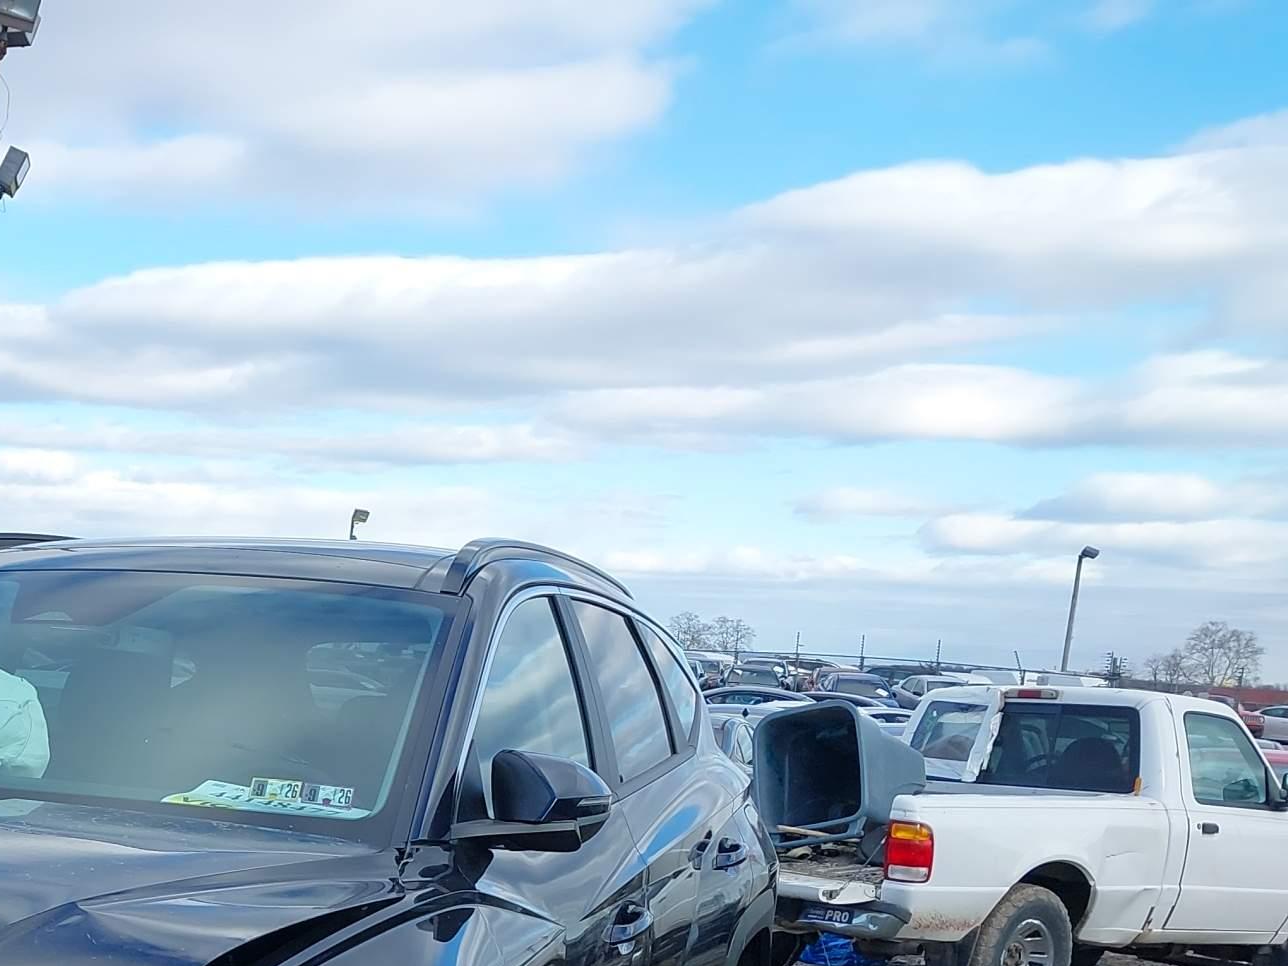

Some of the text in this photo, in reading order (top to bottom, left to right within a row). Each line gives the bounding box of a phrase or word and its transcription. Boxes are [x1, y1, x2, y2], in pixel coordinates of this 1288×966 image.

[284, 783, 300, 799] 26
[337, 788, 353, 804] 26
[824, 909, 850, 923] PRO
